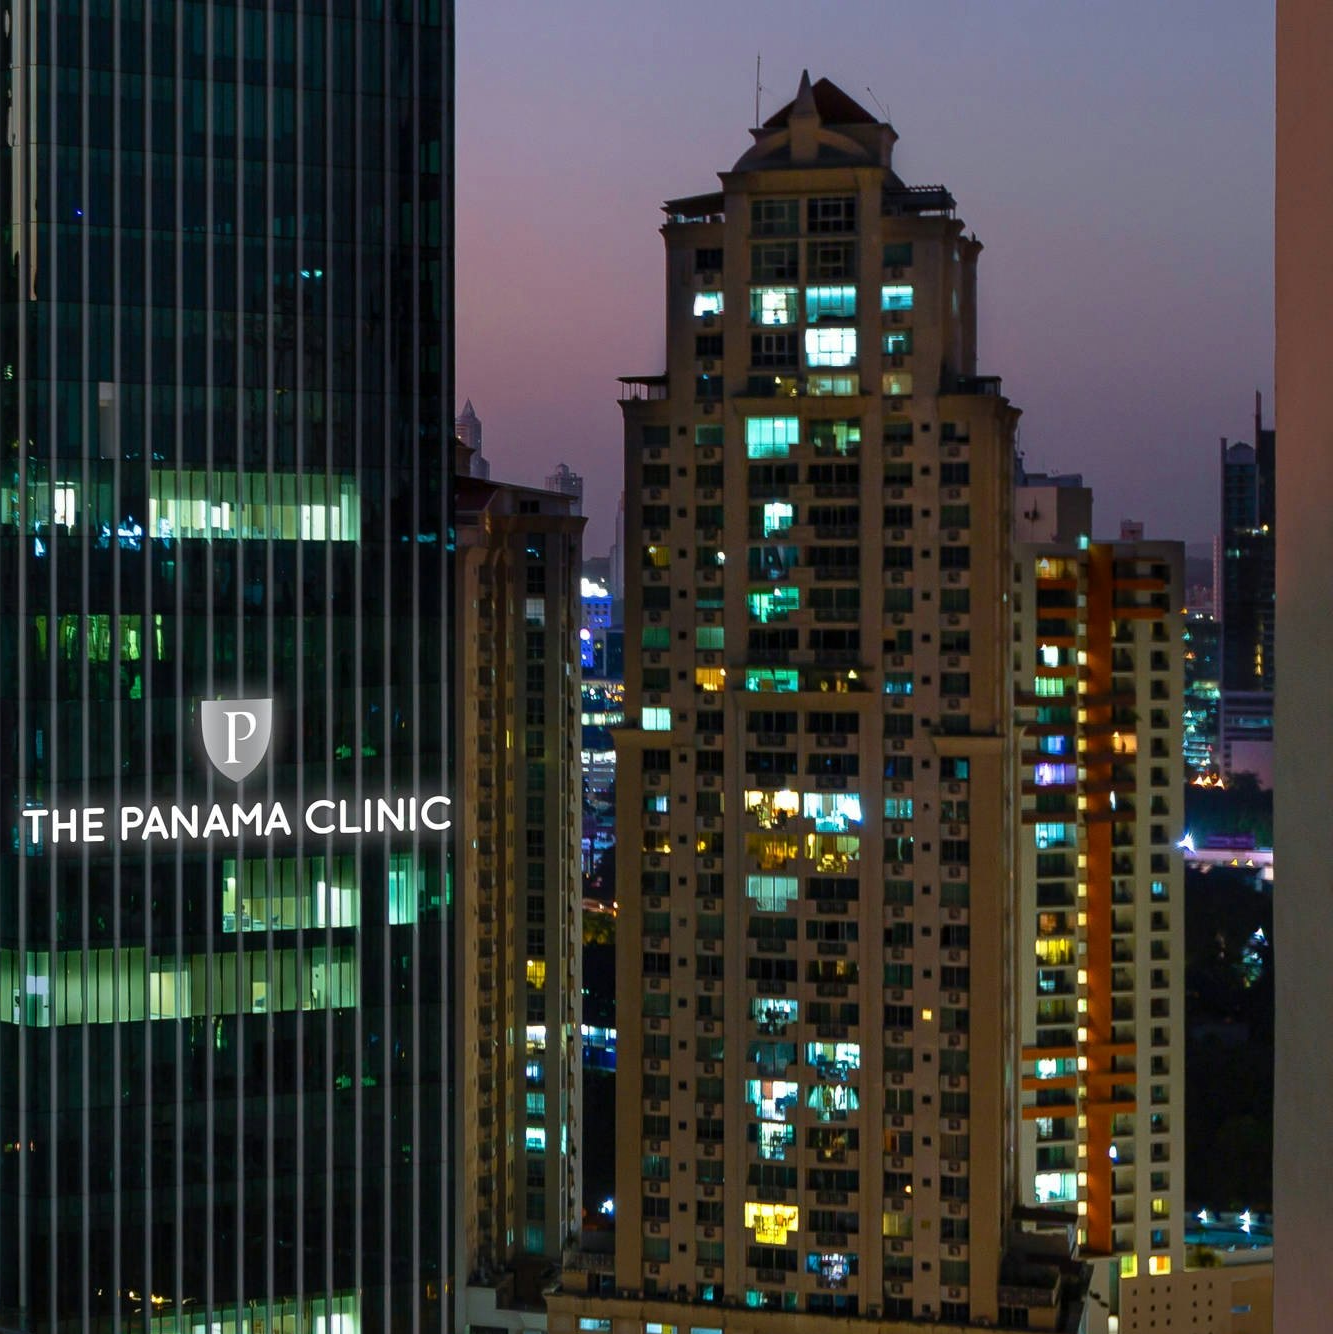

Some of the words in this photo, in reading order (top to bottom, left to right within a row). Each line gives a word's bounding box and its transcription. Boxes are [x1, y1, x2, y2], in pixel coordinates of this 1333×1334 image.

[223, 711, 256, 764] P
[22, 807, 105, 843] THE
[121, 802, 291, 840] PANAMA
[305, 796, 451, 834] CLINIC
